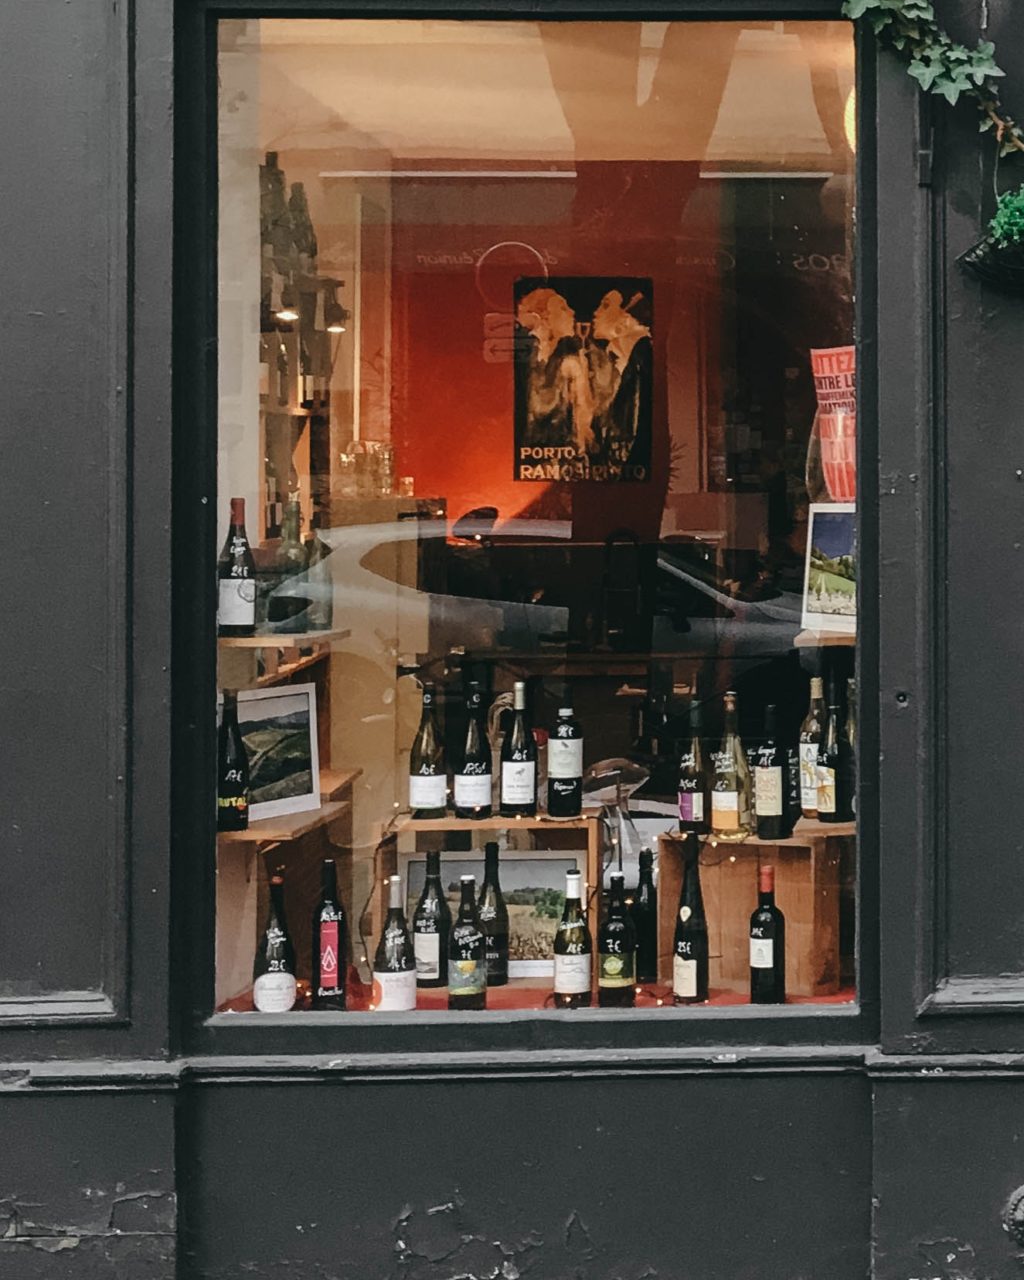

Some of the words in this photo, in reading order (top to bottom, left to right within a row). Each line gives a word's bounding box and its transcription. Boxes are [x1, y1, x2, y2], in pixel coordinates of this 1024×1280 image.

[520, 447, 577, 460] PORTO
[520, 464, 585, 481] RAMOS
[606, 939, 622, 953] 7€
